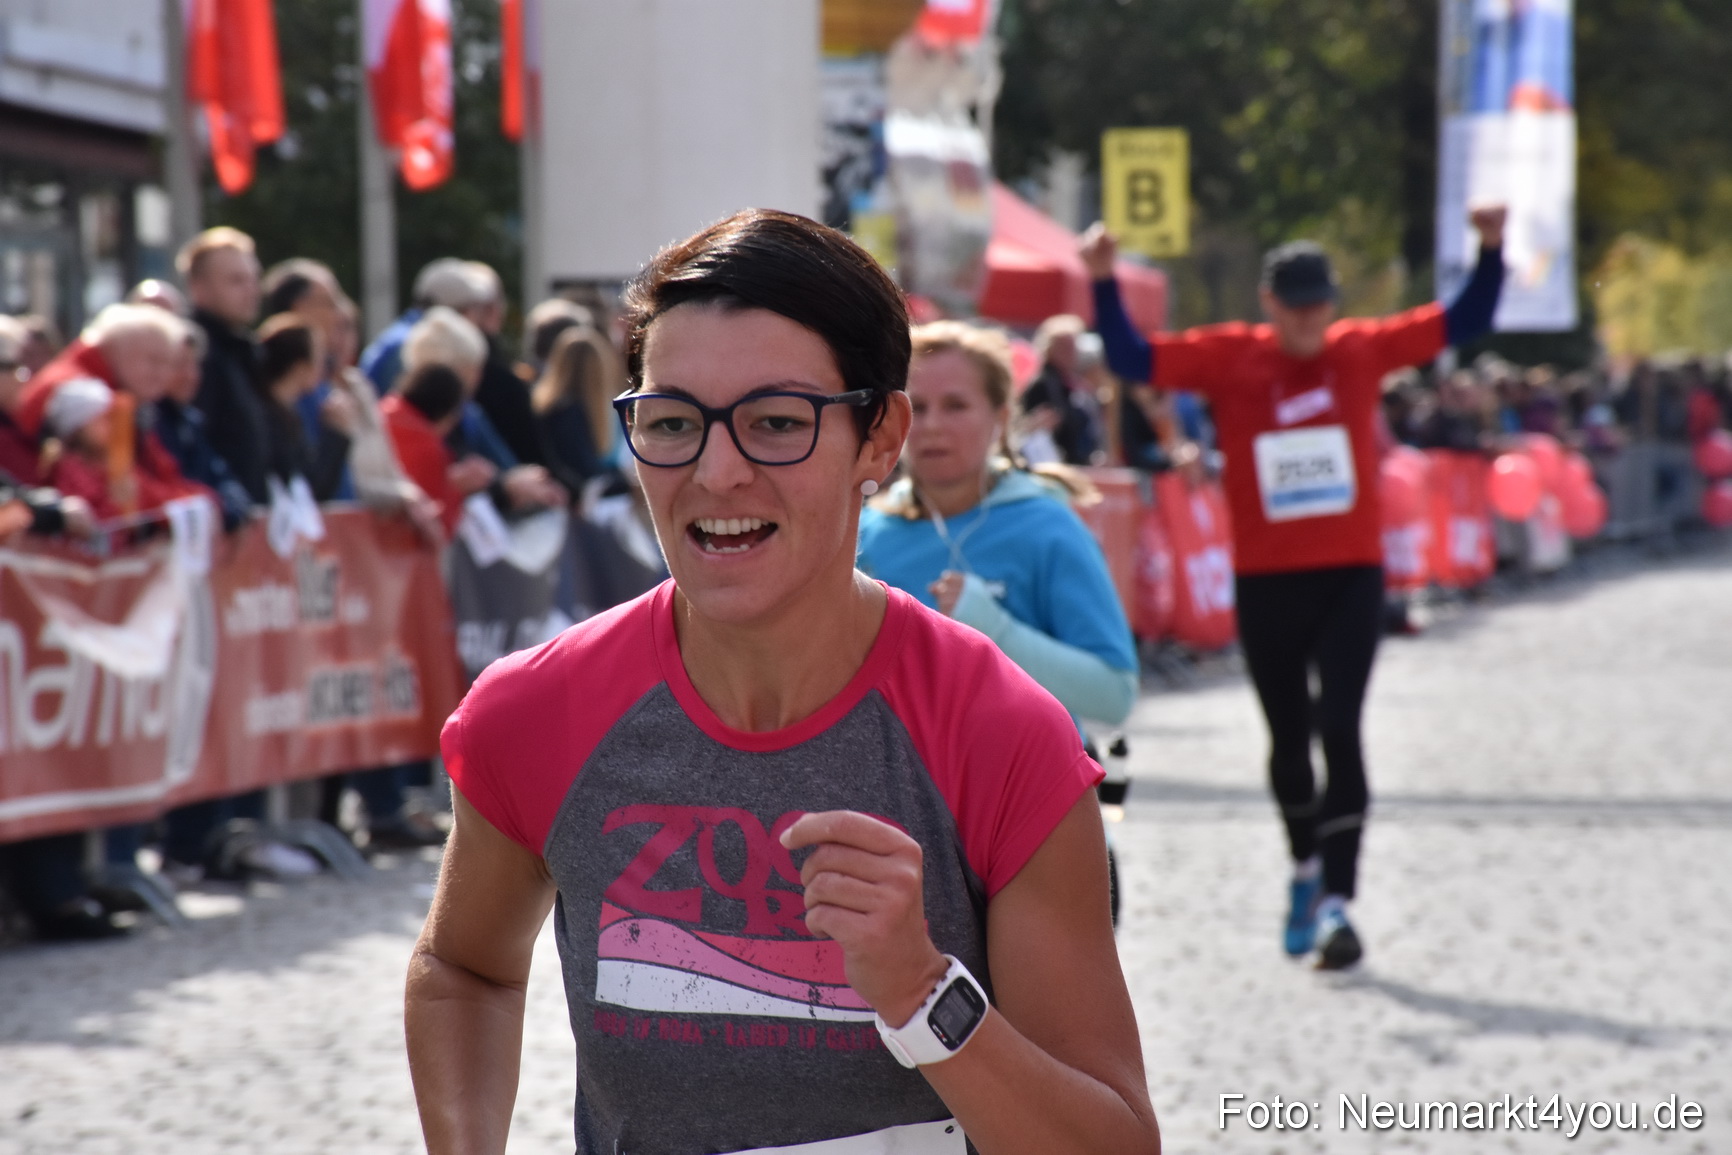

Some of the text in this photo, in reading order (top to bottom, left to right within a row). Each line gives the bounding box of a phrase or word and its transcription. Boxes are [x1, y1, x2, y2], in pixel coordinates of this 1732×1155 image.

[1127, 169, 1165, 225] B
[633, 1016, 651, 1040] IN
[724, 1021, 790, 1048] RAISED
[798, 1025, 817, 1050] IN
